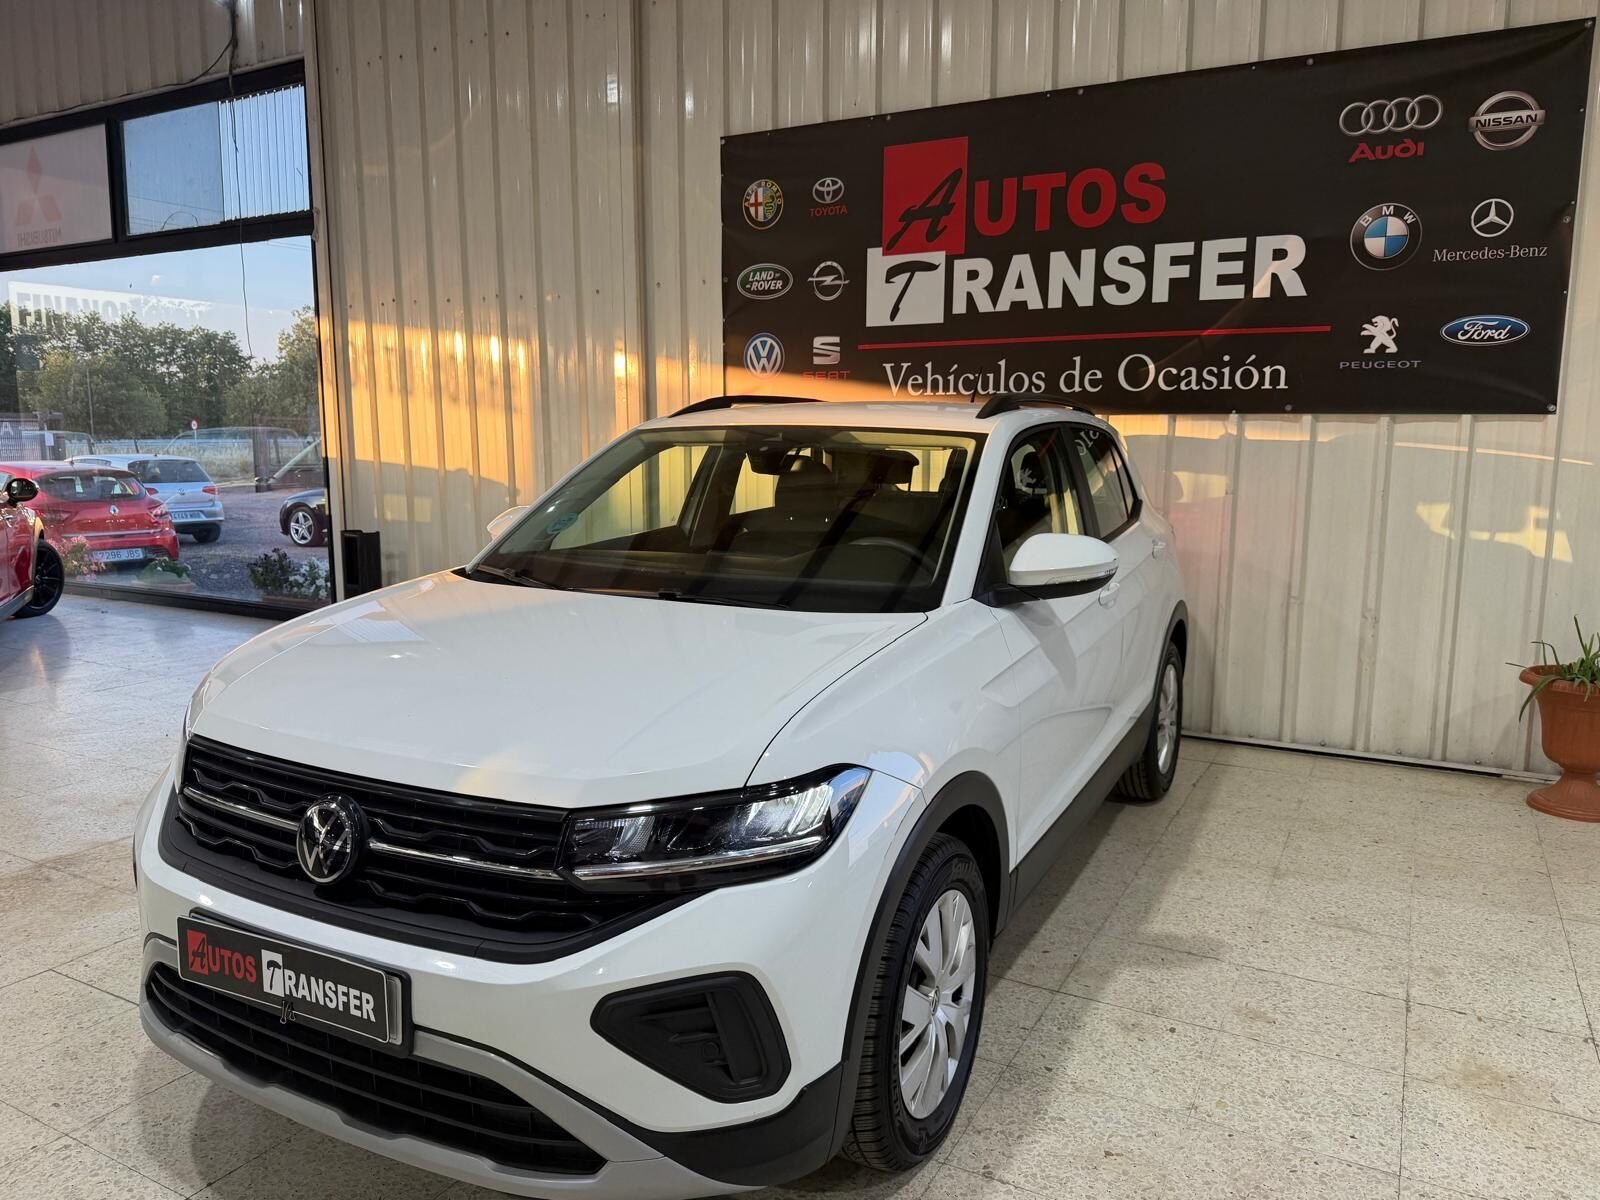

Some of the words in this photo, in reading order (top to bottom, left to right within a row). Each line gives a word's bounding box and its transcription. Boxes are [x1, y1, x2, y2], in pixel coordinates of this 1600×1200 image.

[1475, 113, 1538, 128] NISSAN
[1349, 139, 1425, 162] Audi
[810, 205, 848, 217] TOYOTA
[1432, 245, 1548, 262] Mercedes-Benz
[749, 272, 774, 281] LAND
[751, 279, 783, 291] ROVER
[1457, 320, 1510, 340] Ford
[1339, 360, 1422, 370] PEUGEOT
[801, 370, 851, 381] SEAT
[882, 358, 1045, 397] Vehículos
[1059, 356, 1102, 394] de
[1117, 353, 1289, 393] Ocasión
[266, 957, 376, 1023] TRANSFER
